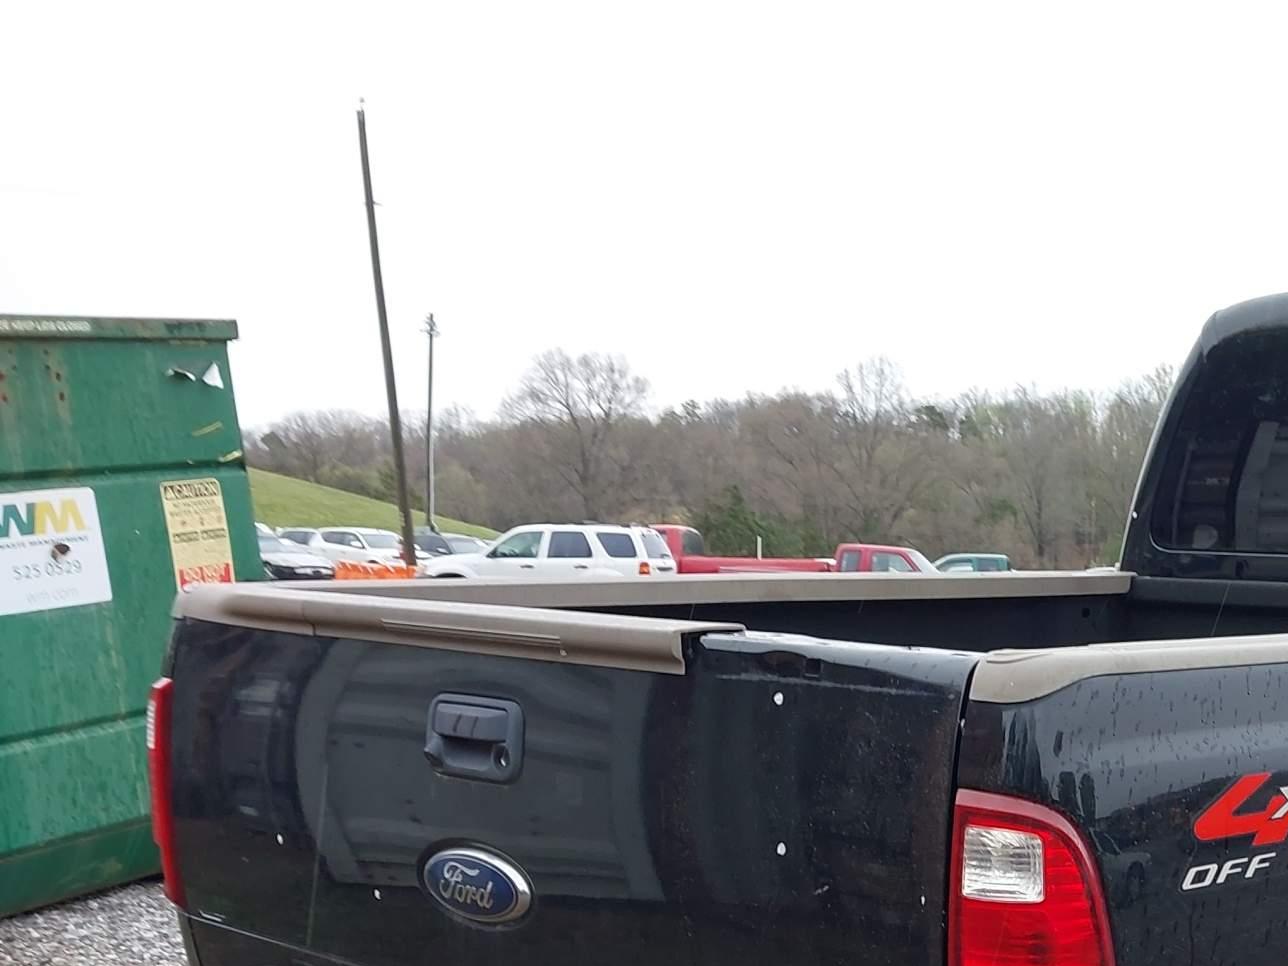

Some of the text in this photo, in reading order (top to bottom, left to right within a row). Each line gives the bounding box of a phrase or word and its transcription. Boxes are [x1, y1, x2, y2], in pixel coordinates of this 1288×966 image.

[0, 499, 87, 538] WM
[440, 861, 493, 909] Ford
[1181, 851, 1277, 891] OFF
